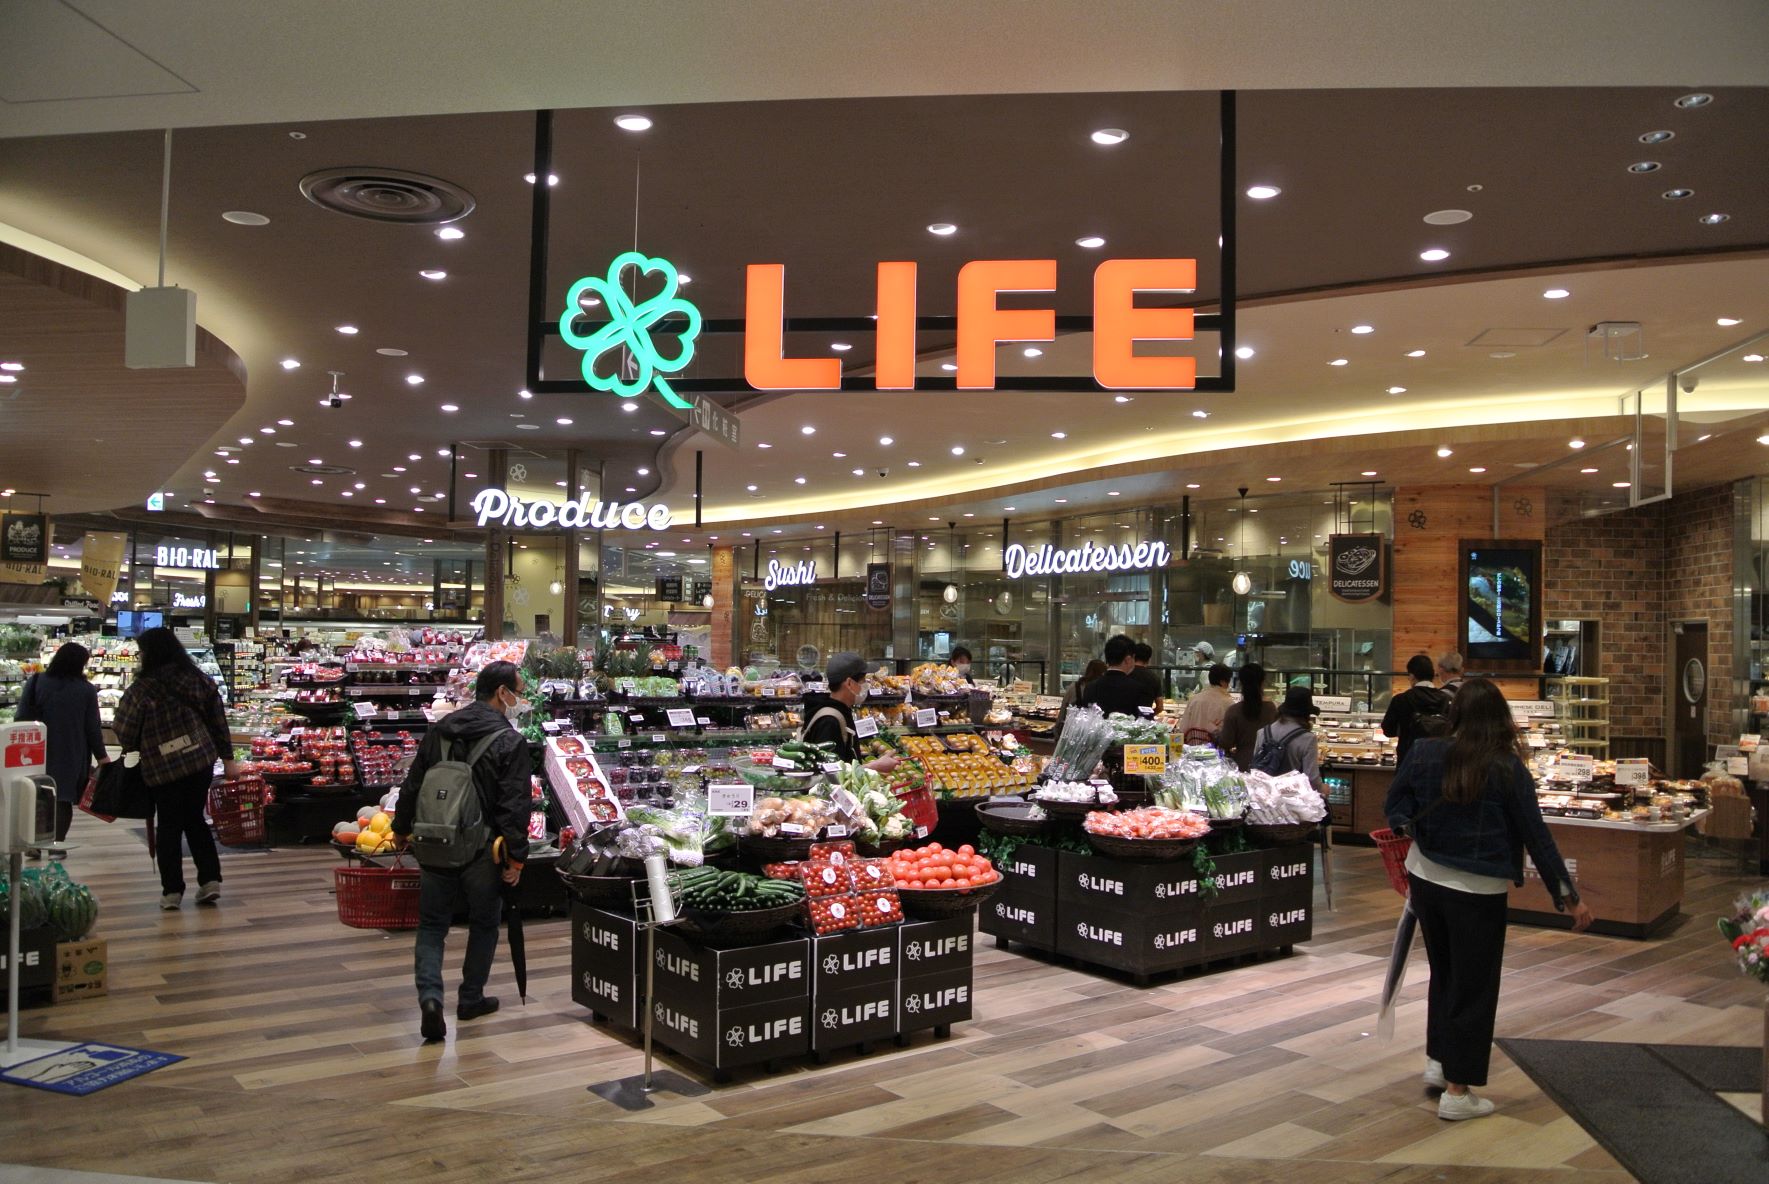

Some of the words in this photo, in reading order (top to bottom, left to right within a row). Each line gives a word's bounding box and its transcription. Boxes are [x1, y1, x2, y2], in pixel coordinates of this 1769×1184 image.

[744, 258, 1197, 391] LIFE
[473, 488, 672, 531] Produce
[156, 546, 220, 569] BIO-RAL
[1005, 540, 1171, 579] Delicatessen
[83, 564, 117, 580] BIO-RAL
[764, 559, 817, 592] Sushi
[1333, 579, 1380, 588] DELICATESSEN
[1142, 756, 1161, 766] 400
[1577, 768, 1591, 776] 298
[734, 800, 748, 808] 29
[1226, 870, 1255, 887] LIFE
[1281, 862, 1307, 878] LIFE
[1091, 876, 1124, 896] LIFE
[1167, 879, 1197, 897] LIFE
[1007, 907, 1035, 925] LIFE
[1224, 918, 1253, 936] LIFE
[1279, 908, 1306, 925] LIFE
[591, 926, 619, 951] LIFE
[924, 934, 968, 958] LIFE
[1090, 925, 1123, 946] LIFE
[1166, 928, 1197, 948] LIFE
[667, 953, 699, 982] LIFE
[843, 946, 891, 971] LIFE
[749, 960, 801, 986] LIFE
[592, 976, 619, 1003] LIFE
[923, 985, 968, 1010] LIFE
[666, 1008, 698, 1039] LIFE
[841, 999, 889, 1025] LIFE
[749, 1016, 802, 1044] LIFE
